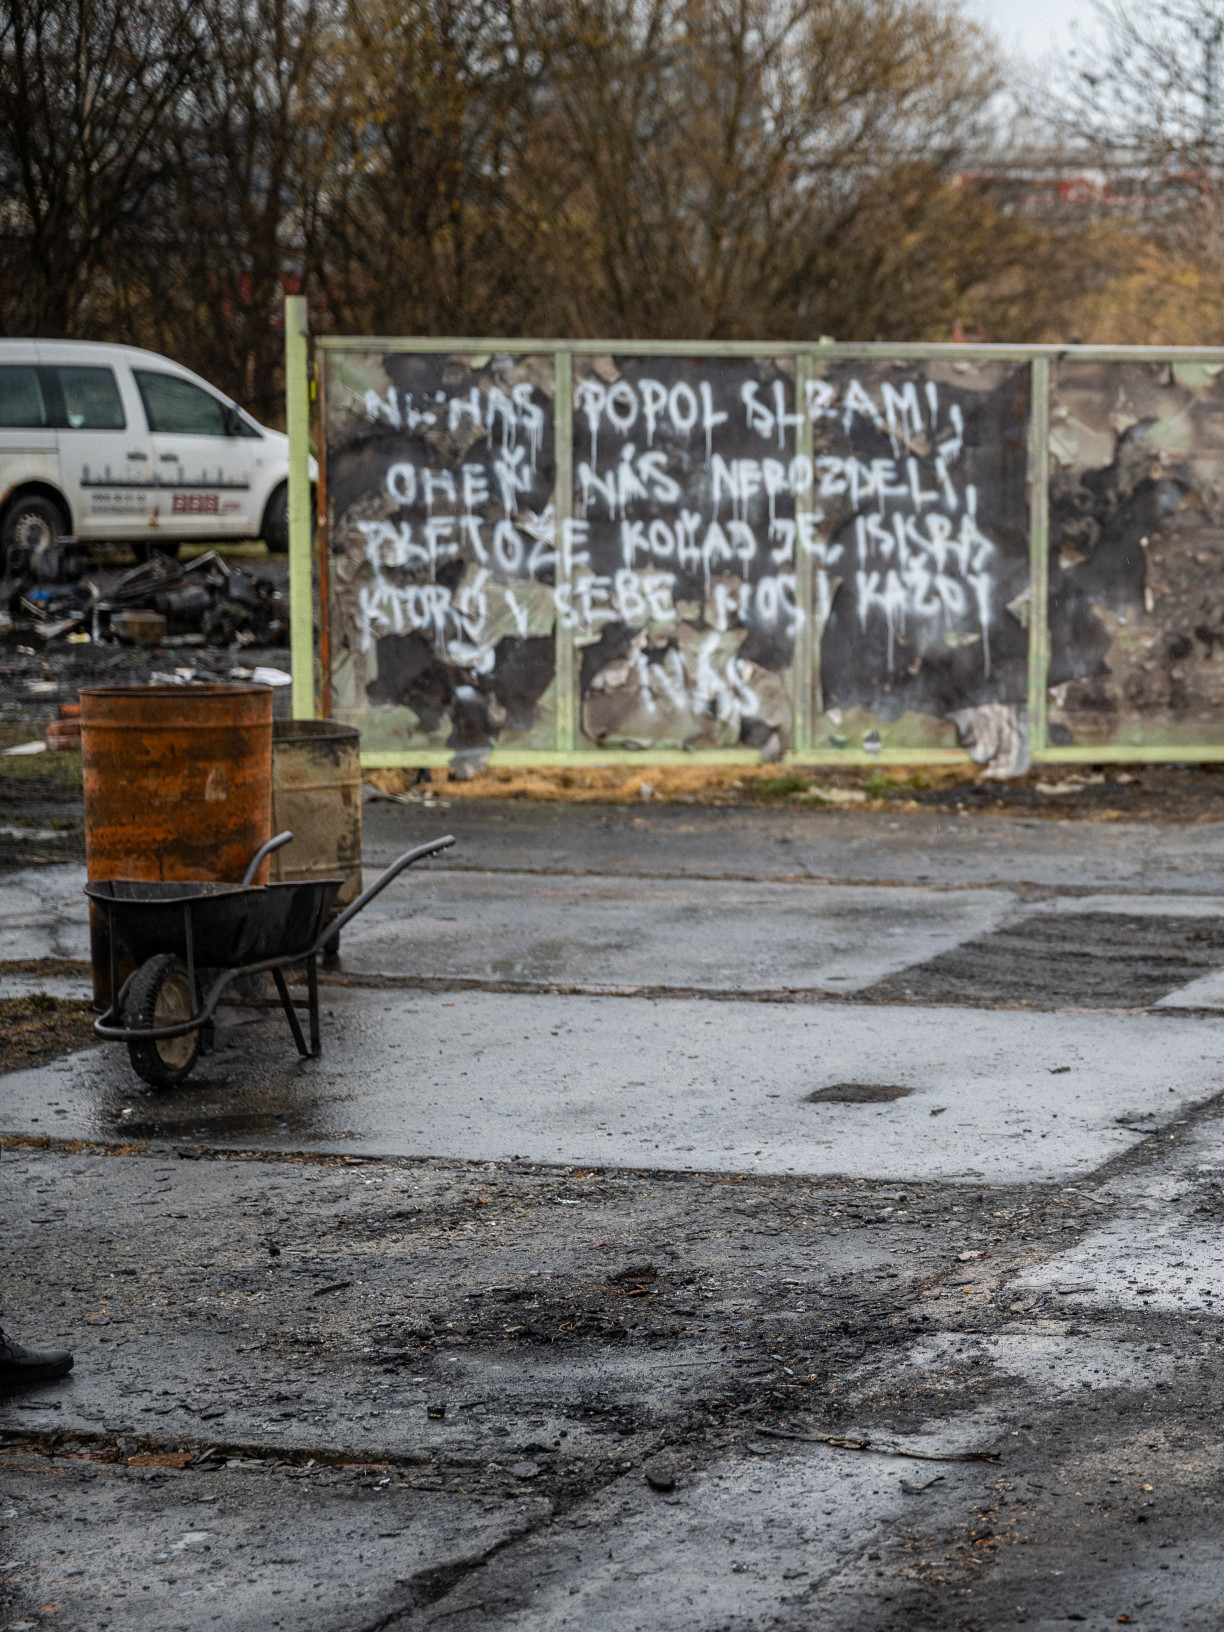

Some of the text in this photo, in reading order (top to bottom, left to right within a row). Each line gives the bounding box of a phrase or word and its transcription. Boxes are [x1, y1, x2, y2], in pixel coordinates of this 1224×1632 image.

[575, 379, 728, 430] POPOL
[577, 442, 682, 505] NÁS
[554, 568, 678, 631] SEBE
